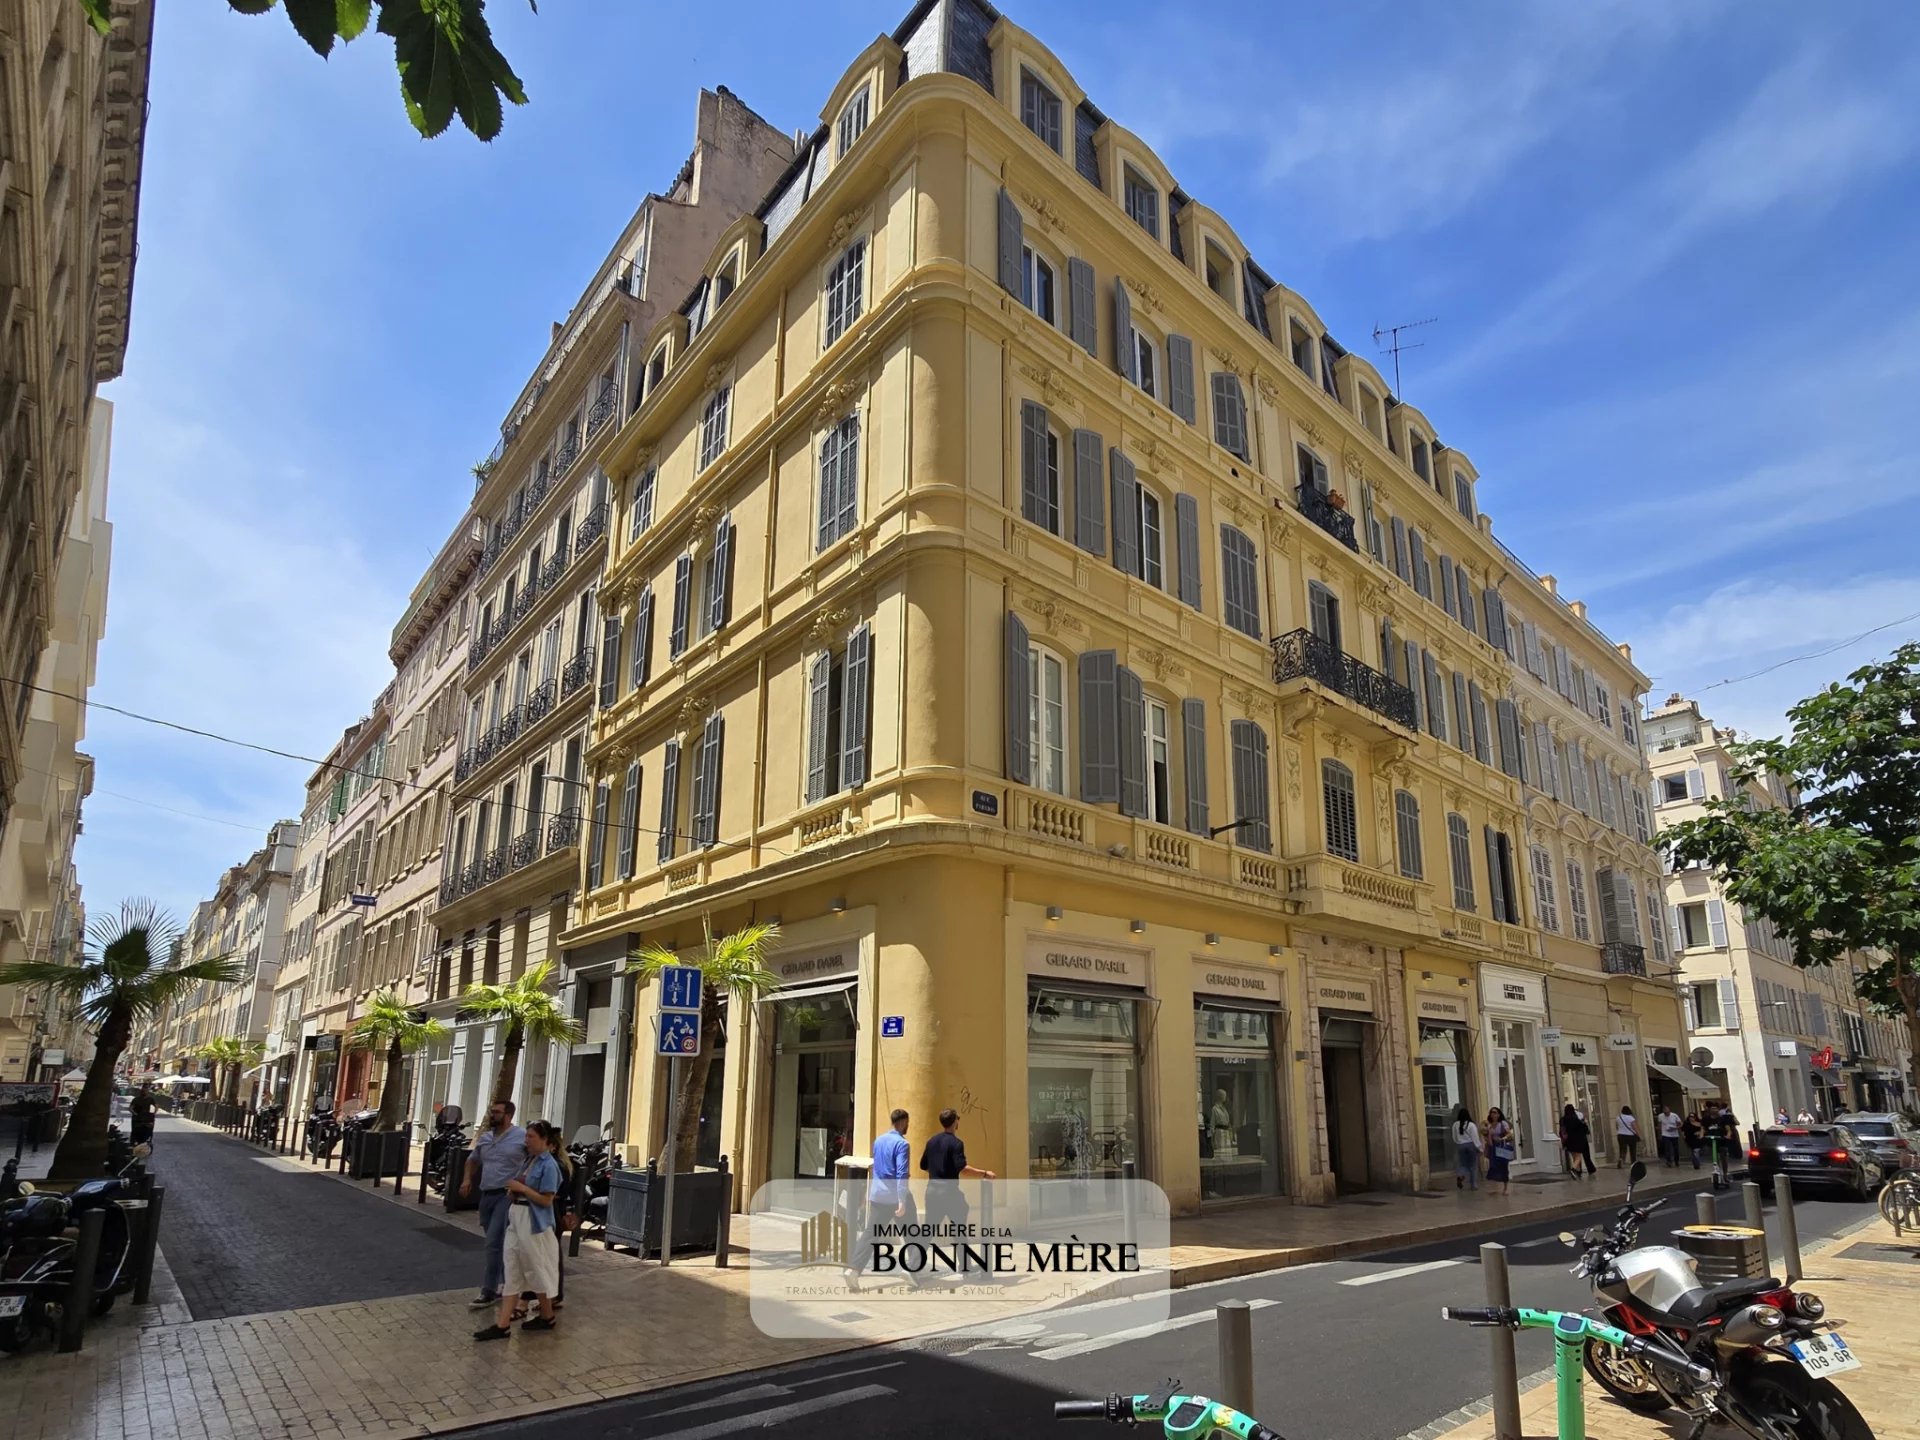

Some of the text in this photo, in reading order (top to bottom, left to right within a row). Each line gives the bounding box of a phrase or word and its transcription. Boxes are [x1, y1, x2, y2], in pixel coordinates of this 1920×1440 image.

[781, 954, 844, 976] GERARD DAREL
[1045, 953, 1129, 975] GERARD DAREL
[1206, 973, 1267, 991] GERARD DAREL
[1319, 988, 1367, 1002] GERARD DAREL
[685, 1040, 694, 1048] 20
